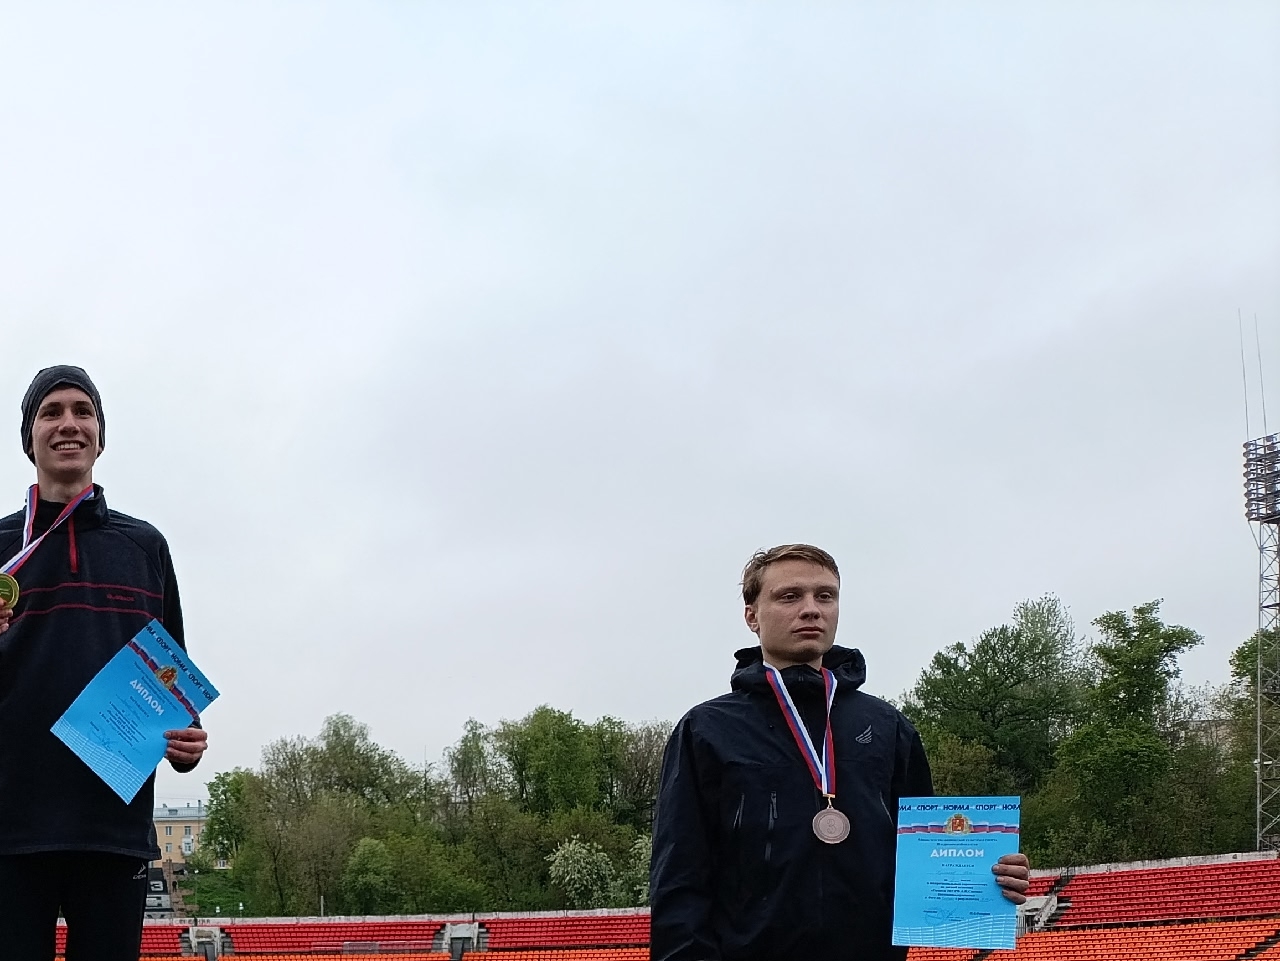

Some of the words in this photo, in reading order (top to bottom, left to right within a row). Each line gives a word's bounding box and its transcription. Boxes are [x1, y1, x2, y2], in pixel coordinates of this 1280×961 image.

[156, 636, 172, 653] СПОРТ
[129, 679, 165, 716] ДИПЛОМ
[930, 849, 985, 858] ДИПЛОМ
